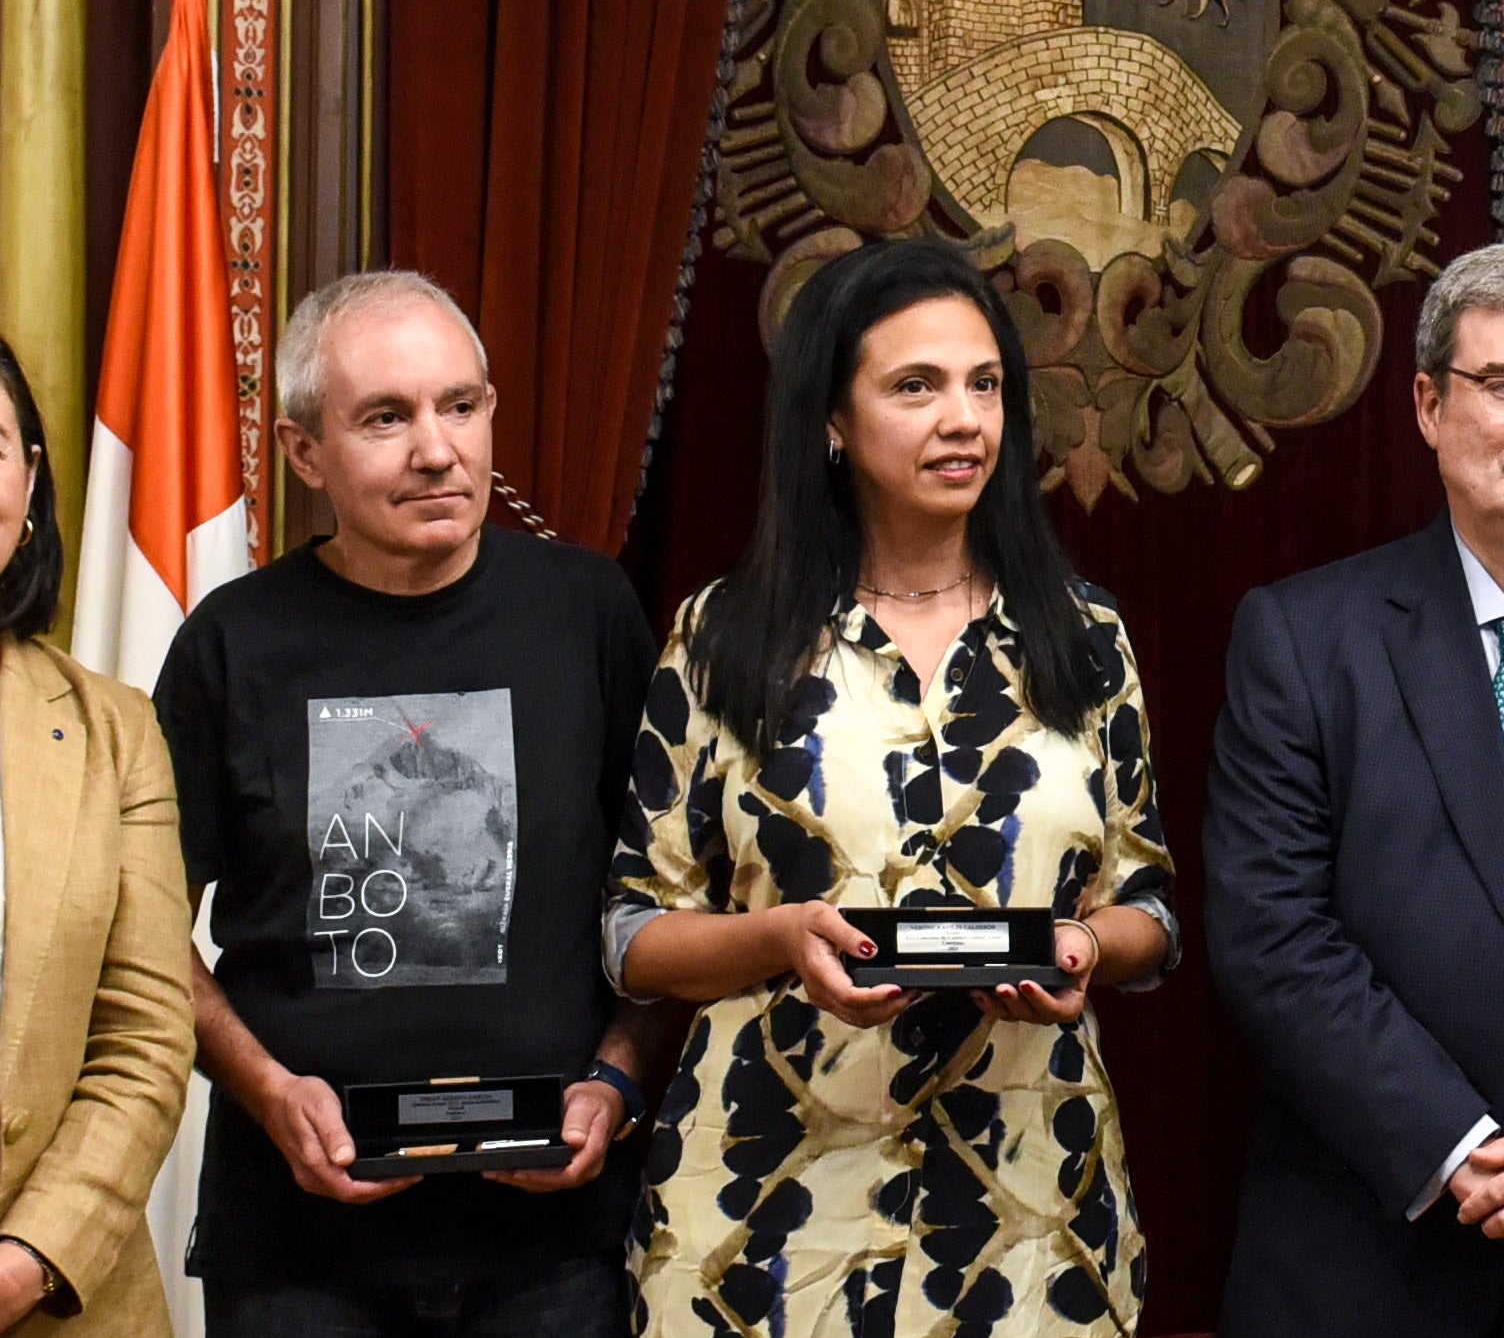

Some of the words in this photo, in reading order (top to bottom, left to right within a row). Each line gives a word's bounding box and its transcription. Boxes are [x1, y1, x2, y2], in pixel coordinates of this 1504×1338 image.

[319, 811, 405, 861] AN
[319, 869, 408, 918] BO
[313, 927, 397, 978] TO
